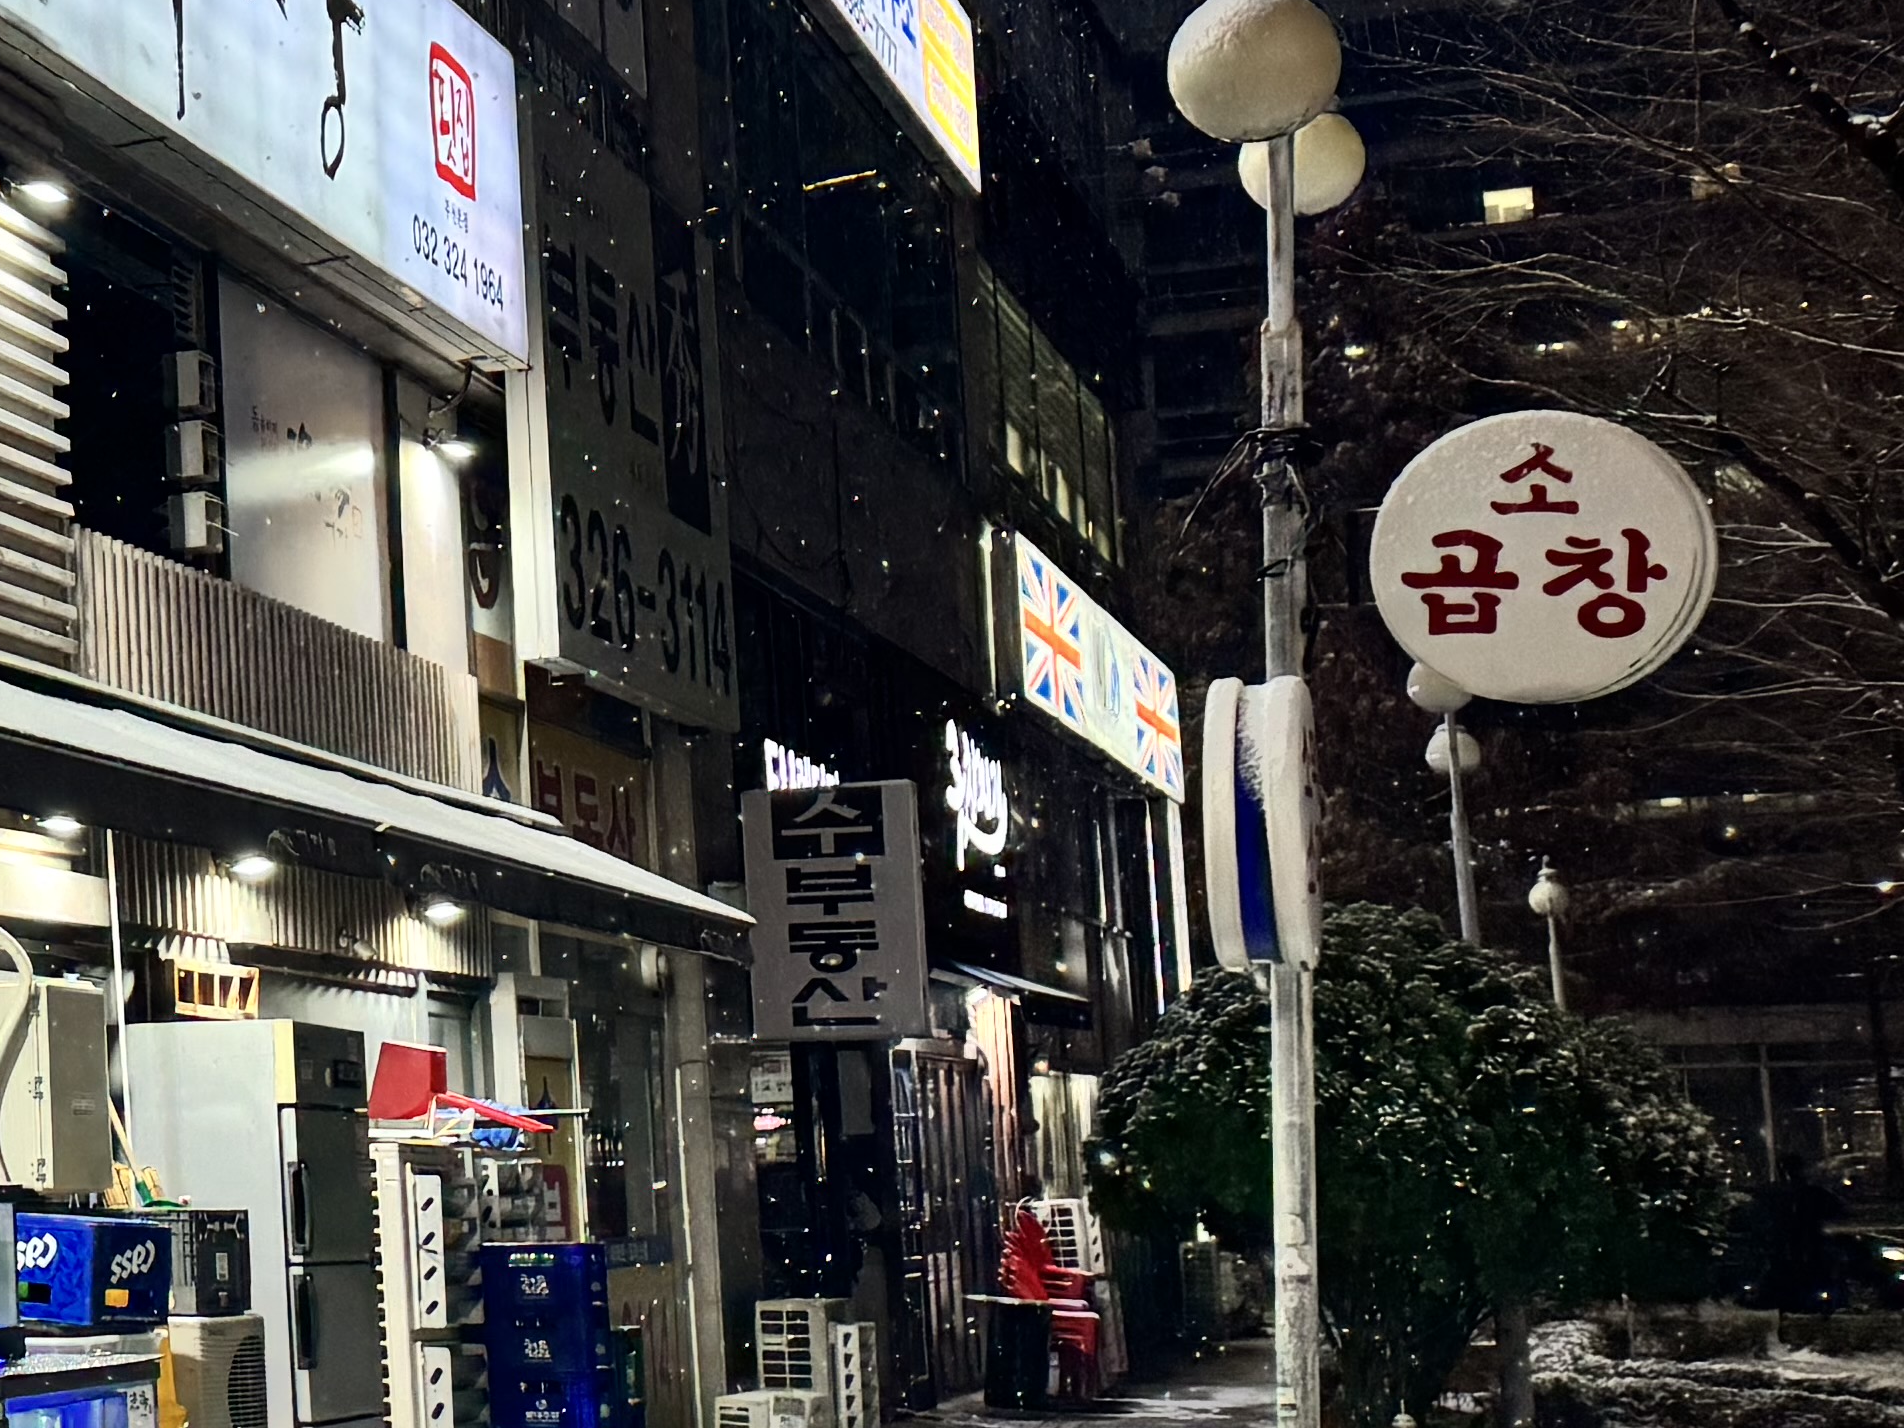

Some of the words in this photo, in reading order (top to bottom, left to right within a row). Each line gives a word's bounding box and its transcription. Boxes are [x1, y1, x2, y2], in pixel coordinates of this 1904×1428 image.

[412, 213, 440, 269] 032
[443, 238, 469, 289] 324
[474, 253, 505, 310] 1964
[1490, 441, 1580, 516] 소
[1400, 528, 1668, 639] 곱창
